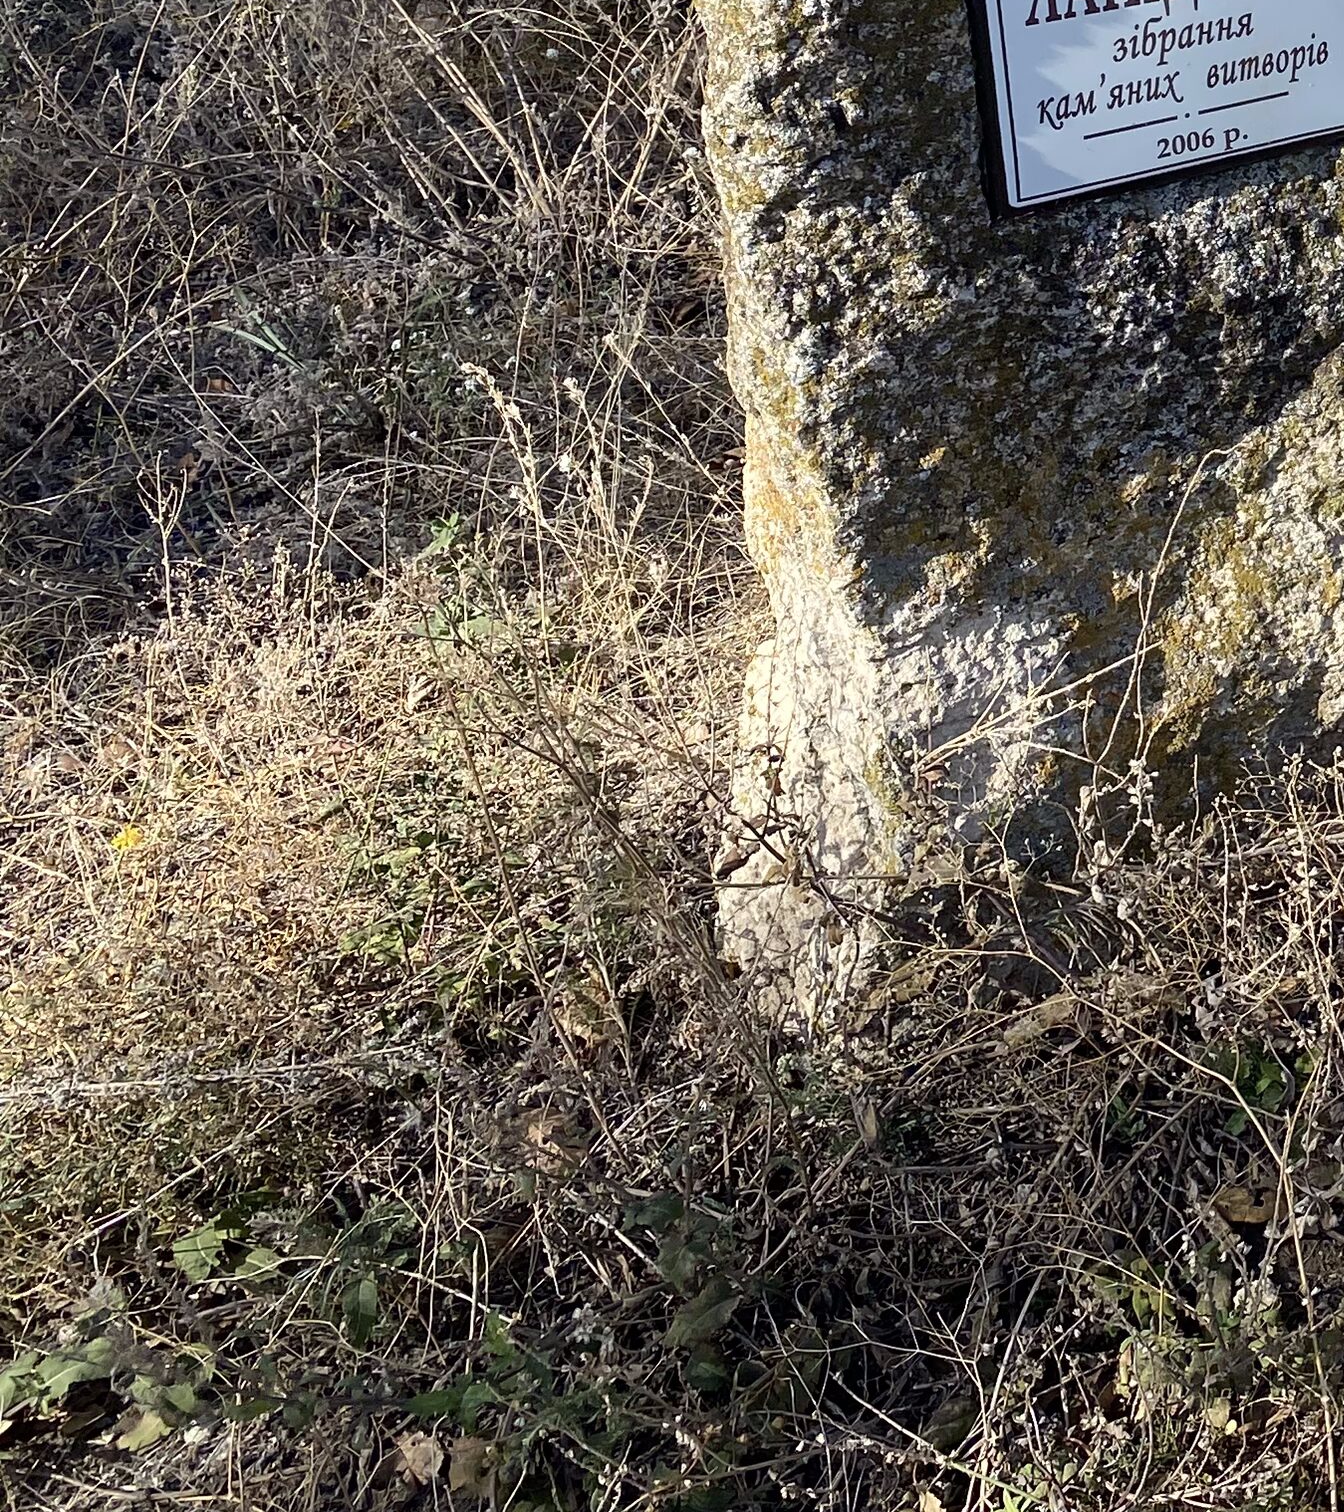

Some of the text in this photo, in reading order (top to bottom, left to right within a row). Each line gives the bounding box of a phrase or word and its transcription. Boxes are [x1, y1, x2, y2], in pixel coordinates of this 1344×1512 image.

[1112, 12, 1254, 66] зібрання
[1036, 33, 1329, 130] кам'яних витворів
[1157, 125, 1248, 159] 2006 р.
